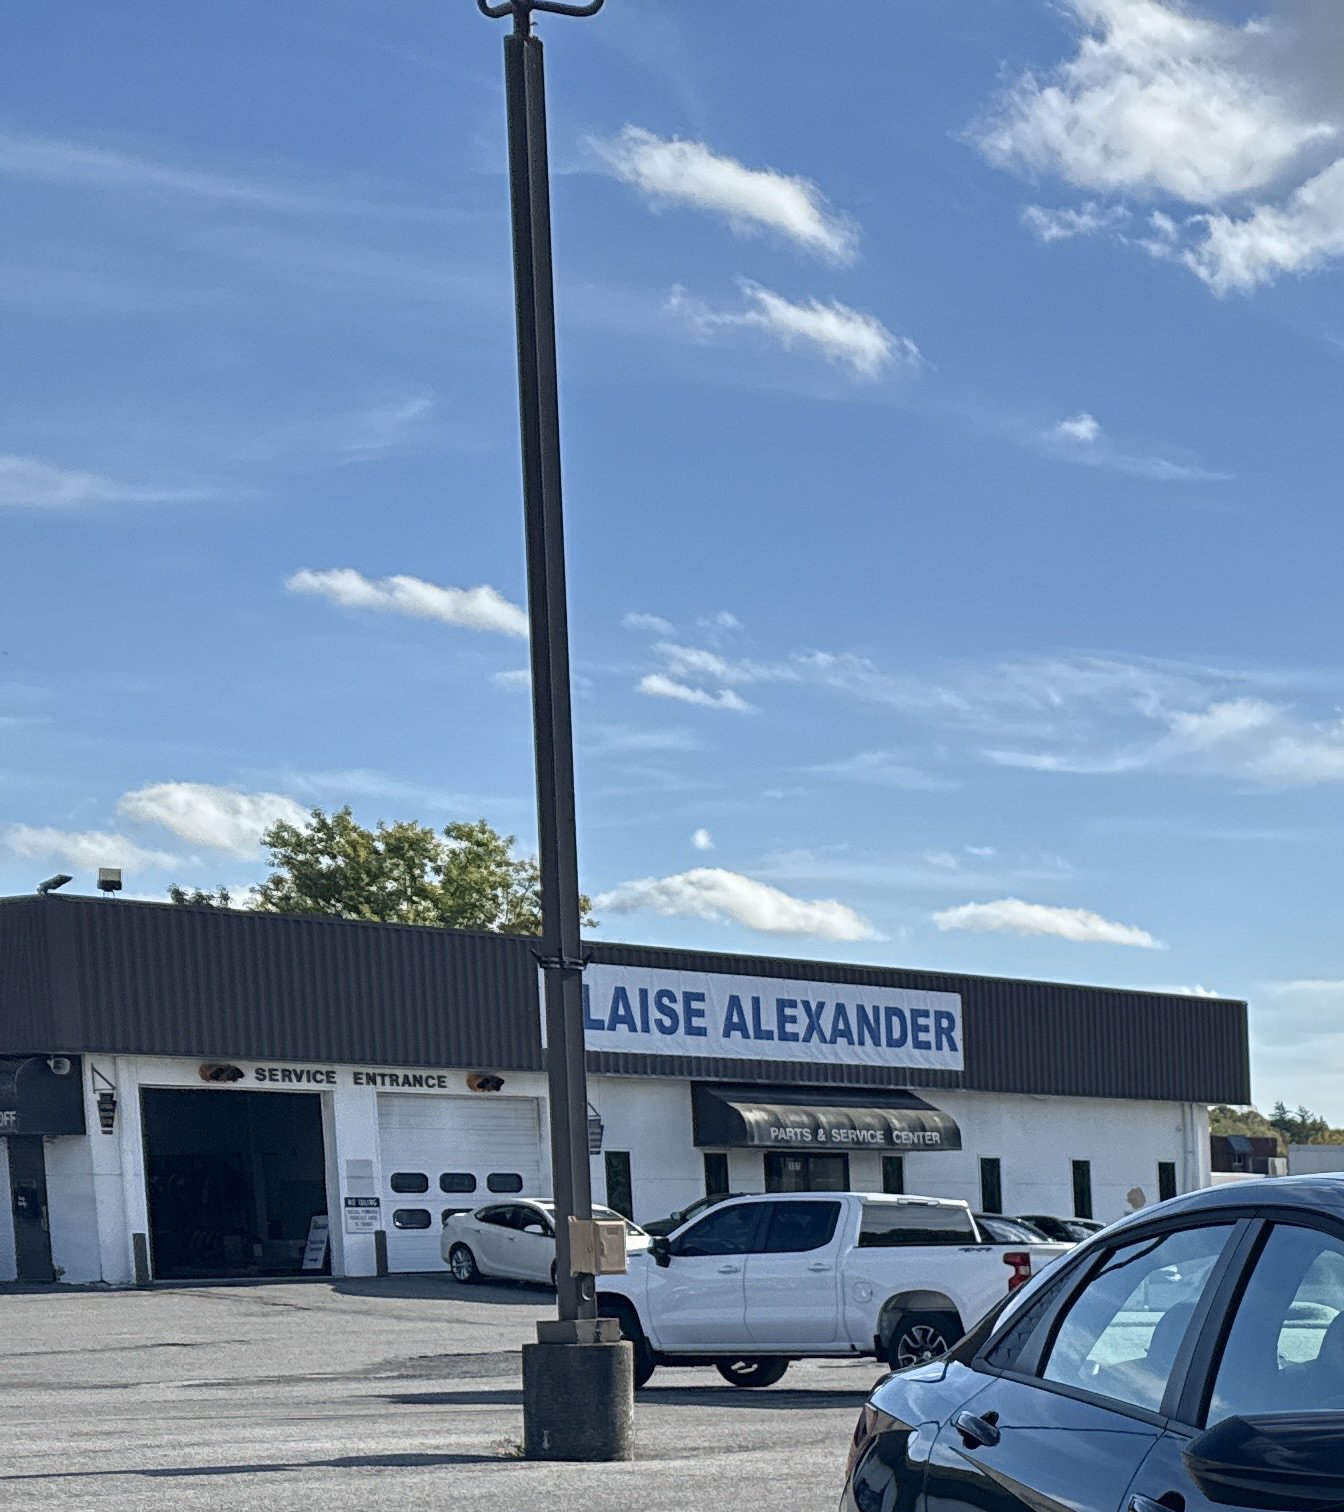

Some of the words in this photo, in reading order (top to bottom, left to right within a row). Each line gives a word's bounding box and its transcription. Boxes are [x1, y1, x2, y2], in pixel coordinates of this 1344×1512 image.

[583, 983, 708, 1037] LAISE
[721, 994, 960, 1053] ALEXANDER
[254, 1067, 337, 1085] SERVICE
[352, 1072, 448, 1089] ENTRANCE
[769, 1126, 813, 1142] PARTS
[817, 1128, 826, 1142] &
[831, 1128, 885, 1144] SERVICE
[892, 1130, 941, 1145] CENTER
